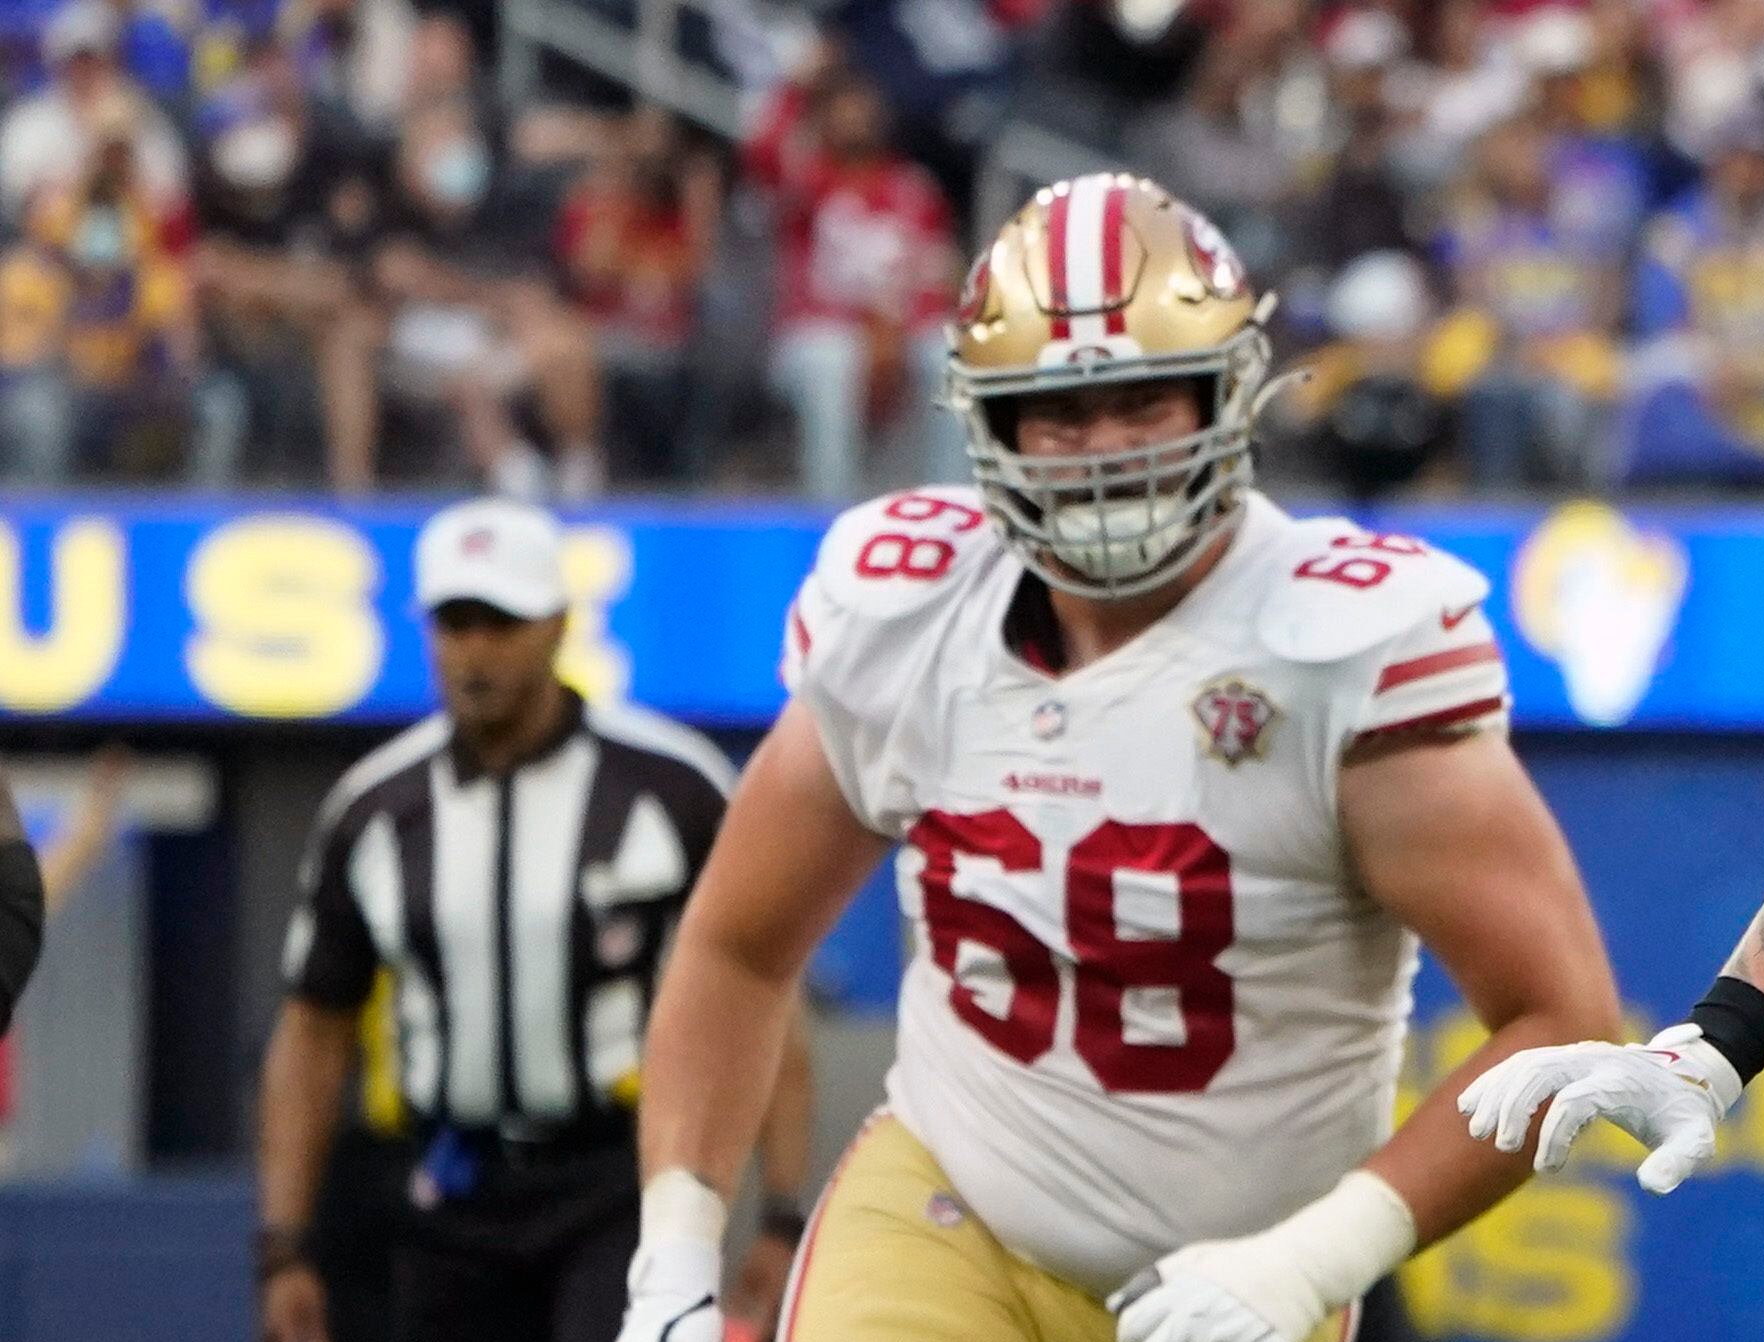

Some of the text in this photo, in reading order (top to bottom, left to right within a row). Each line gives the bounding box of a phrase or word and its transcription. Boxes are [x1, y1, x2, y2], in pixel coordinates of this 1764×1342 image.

[857, 494, 983, 580] 68
[0, 512, 634, 720] US
[1212, 698, 1258, 743] 75
[907, 805, 1236, 1093] 68
